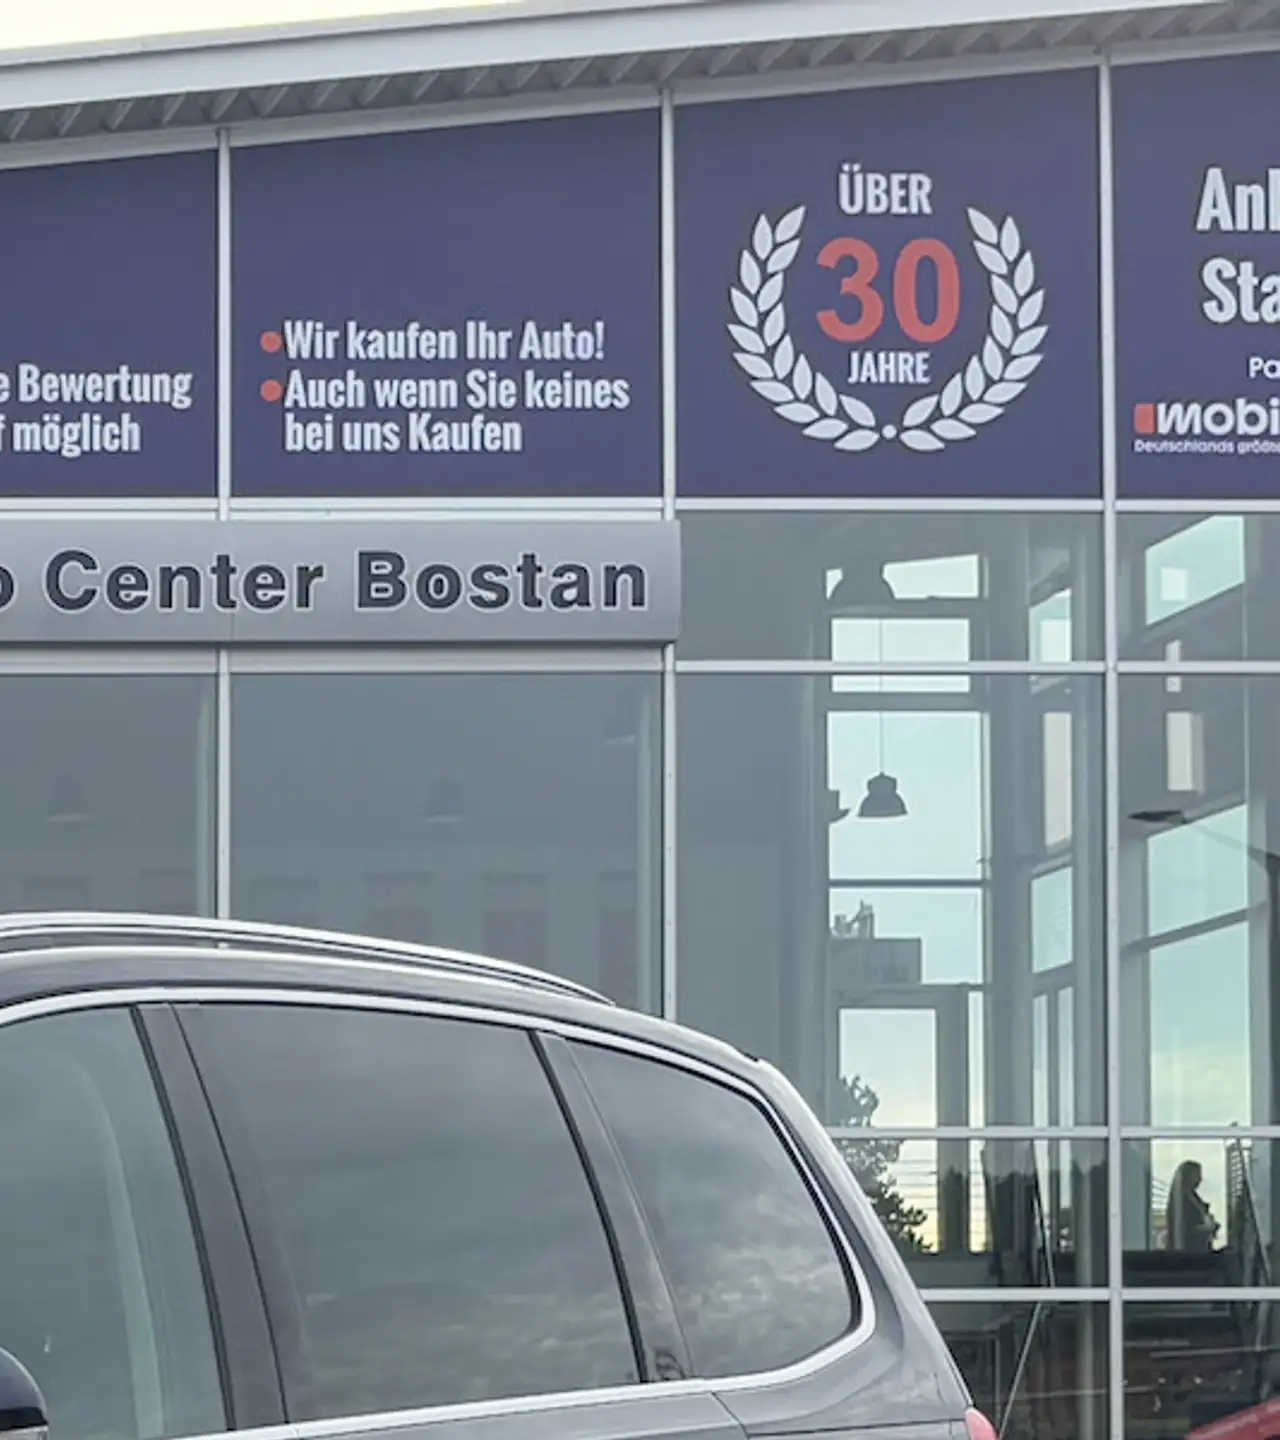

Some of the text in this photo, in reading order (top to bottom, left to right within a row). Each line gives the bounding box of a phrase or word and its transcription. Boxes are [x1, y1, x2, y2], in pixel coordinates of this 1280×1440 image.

[839, 163, 933, 215] ÜBER
[815, 235, 962, 344] 30
[284, 320, 605, 360] Wir kaufen Ihr Auto!
[19, 363, 193, 415] Bewertung
[284, 368, 630, 409] Auch wenn Sie keines
[847, 351, 931, 384] JAHRE
[13, 412, 141, 458] möglich
[285, 411, 522, 452] bei uns Kaufen
[45, 549, 324, 616] Center
[357, 550, 645, 610] Bostan
